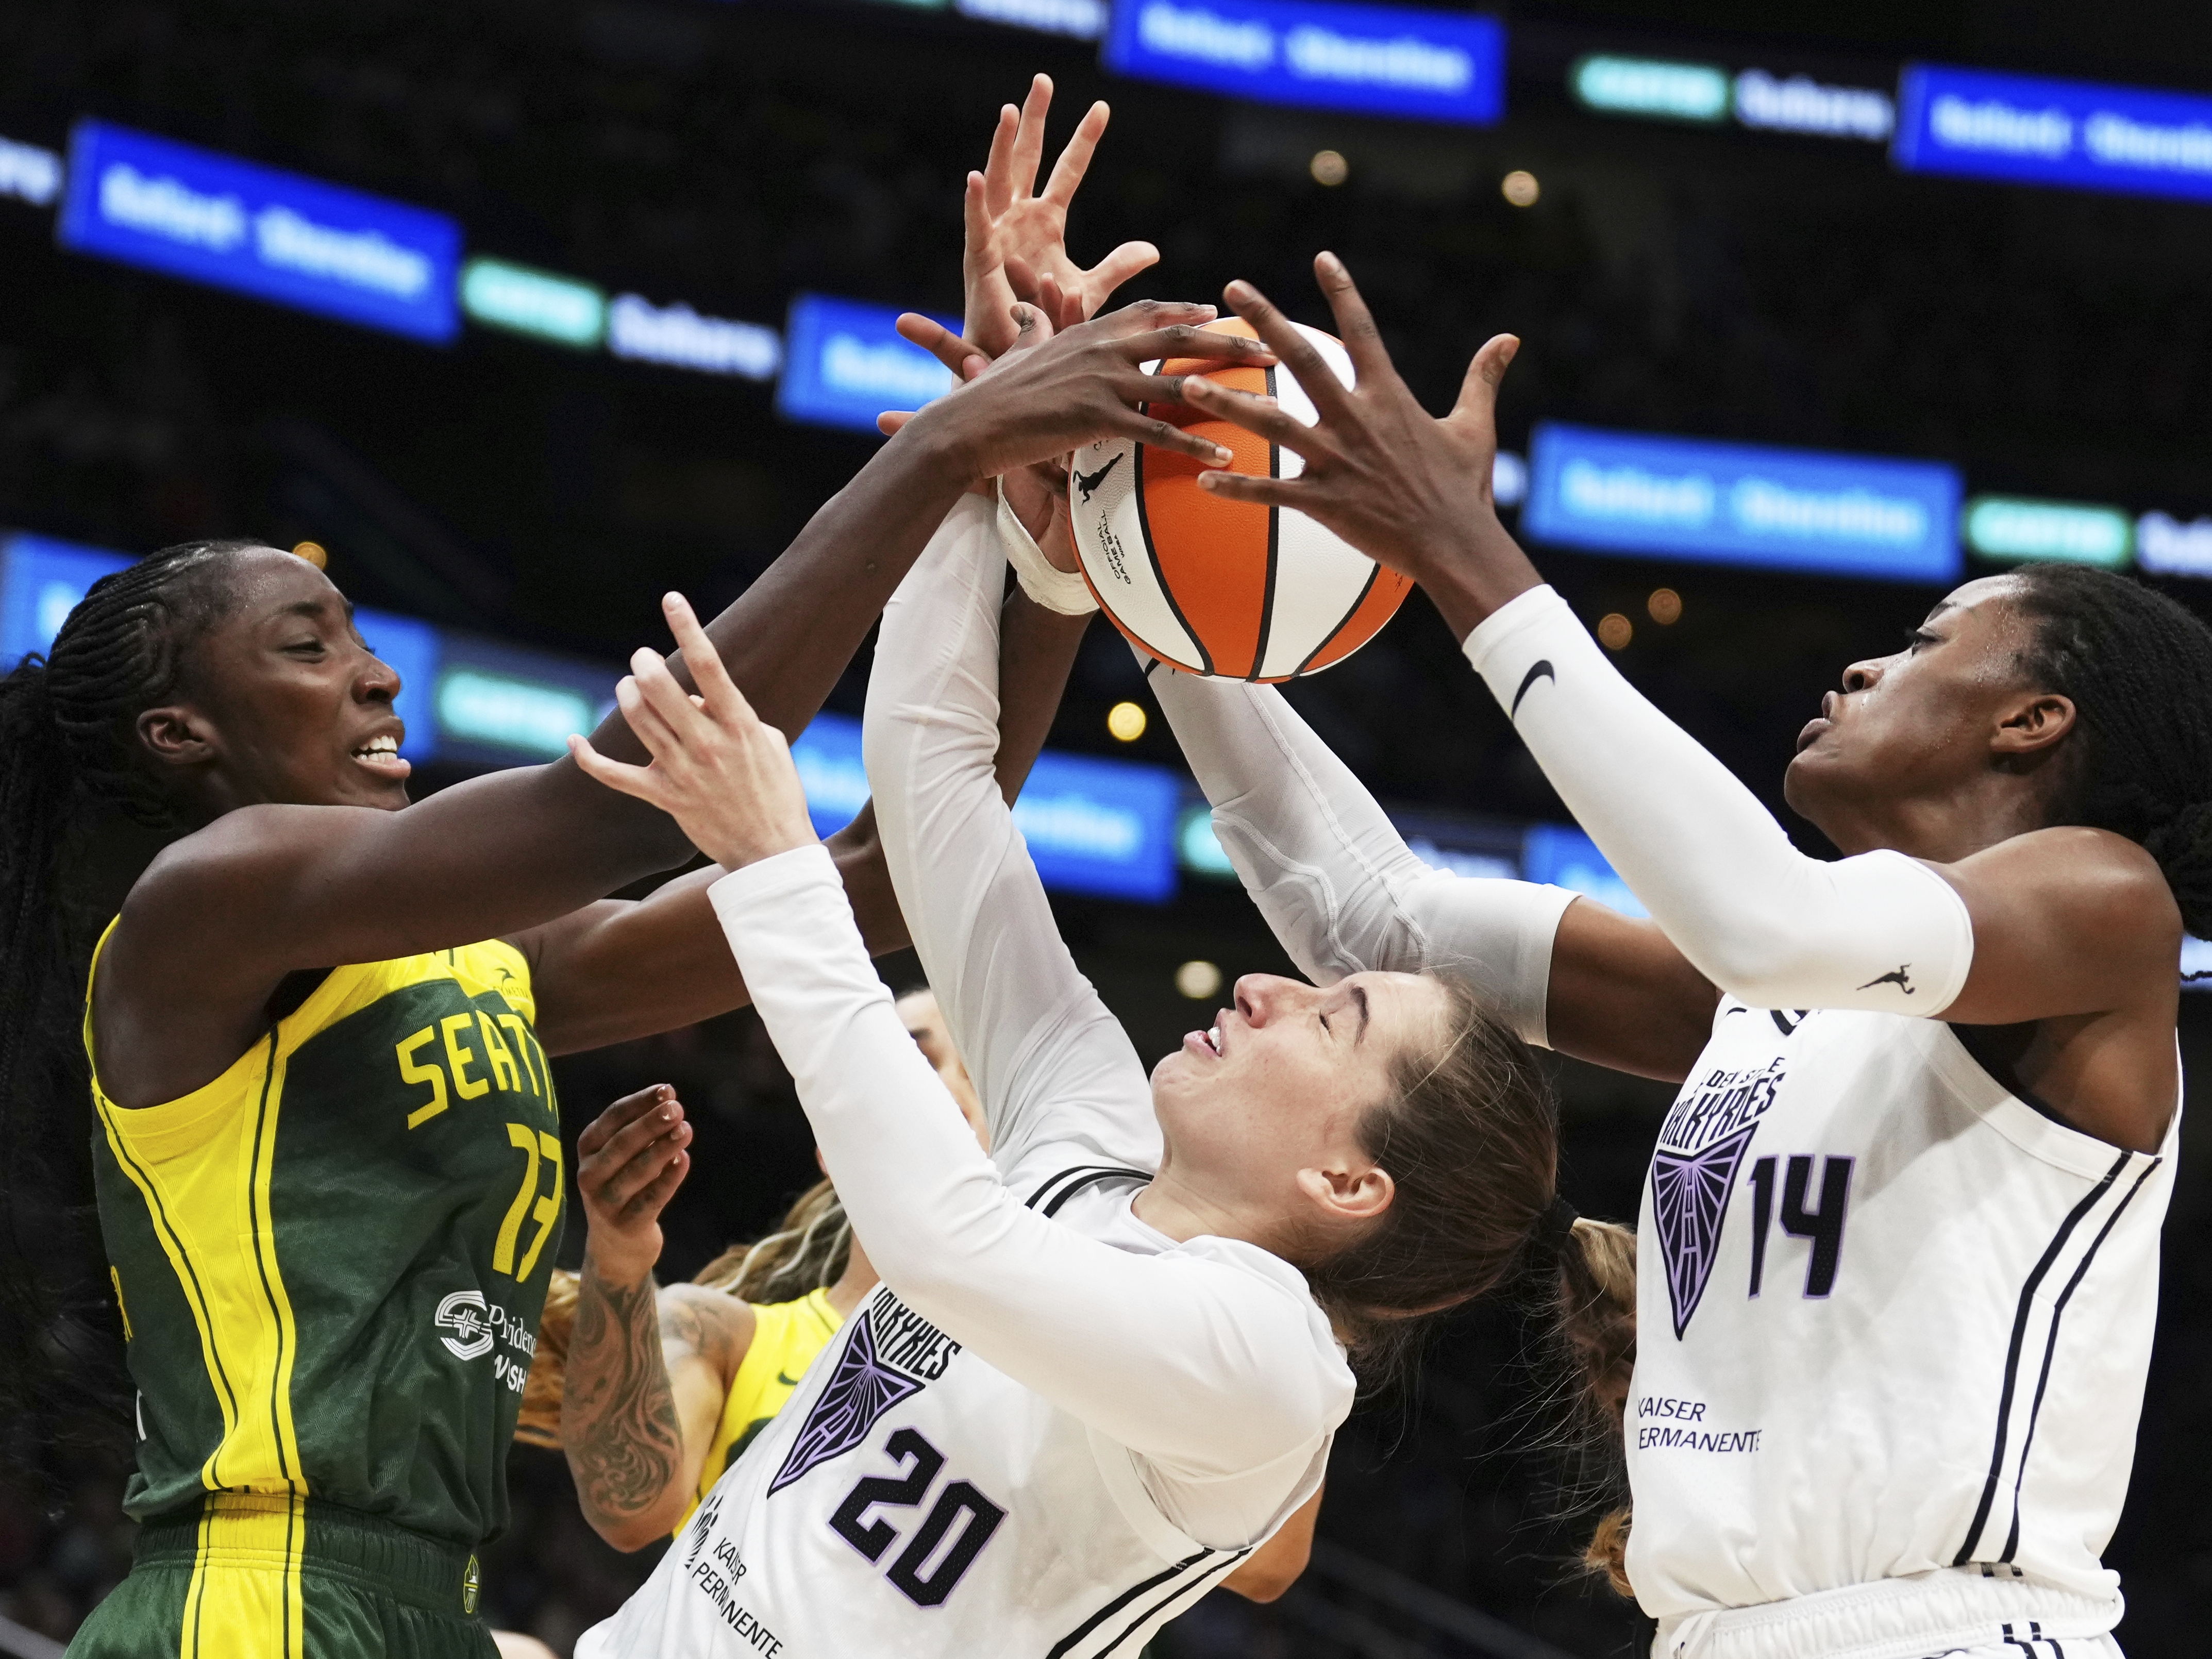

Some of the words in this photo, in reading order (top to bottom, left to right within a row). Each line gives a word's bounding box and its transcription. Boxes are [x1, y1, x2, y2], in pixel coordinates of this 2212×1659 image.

[1097, 521, 1120, 579] OFFICIAL
[1101, 509, 1113, 545] BALL
[1111, 546, 1131, 584] GAME
[395, 1010, 559, 1130] SEATT
[1747, 1153, 1855, 1300] 14
[873, 1286, 963, 1381] ALKYRIES
[827, 1425, 1010, 1610] 20
[692, 1561, 783, 1659] PERMNENTE
